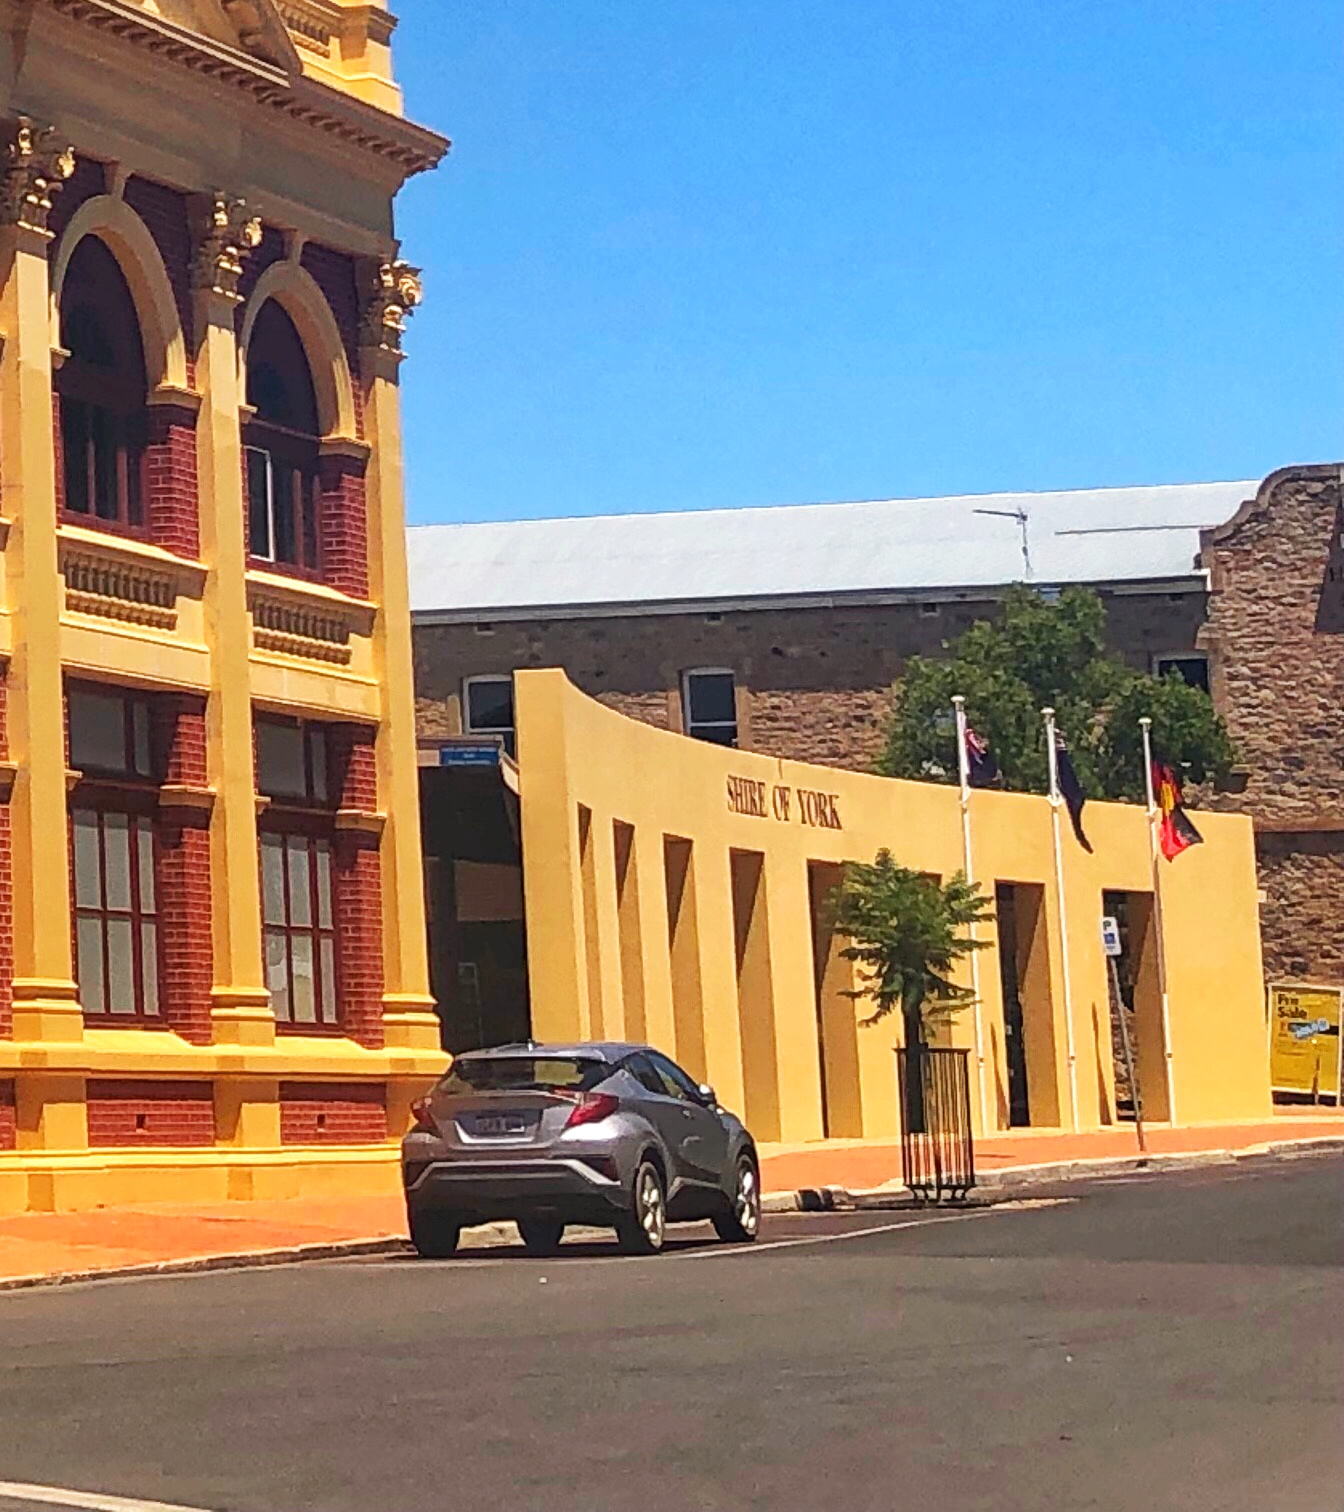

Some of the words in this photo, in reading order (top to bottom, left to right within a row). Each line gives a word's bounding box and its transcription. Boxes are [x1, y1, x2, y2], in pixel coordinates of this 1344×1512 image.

[726, 774, 768, 818] SHIRE
[772, 785, 791, 821] OF
[797, 788, 842, 830] YORK
